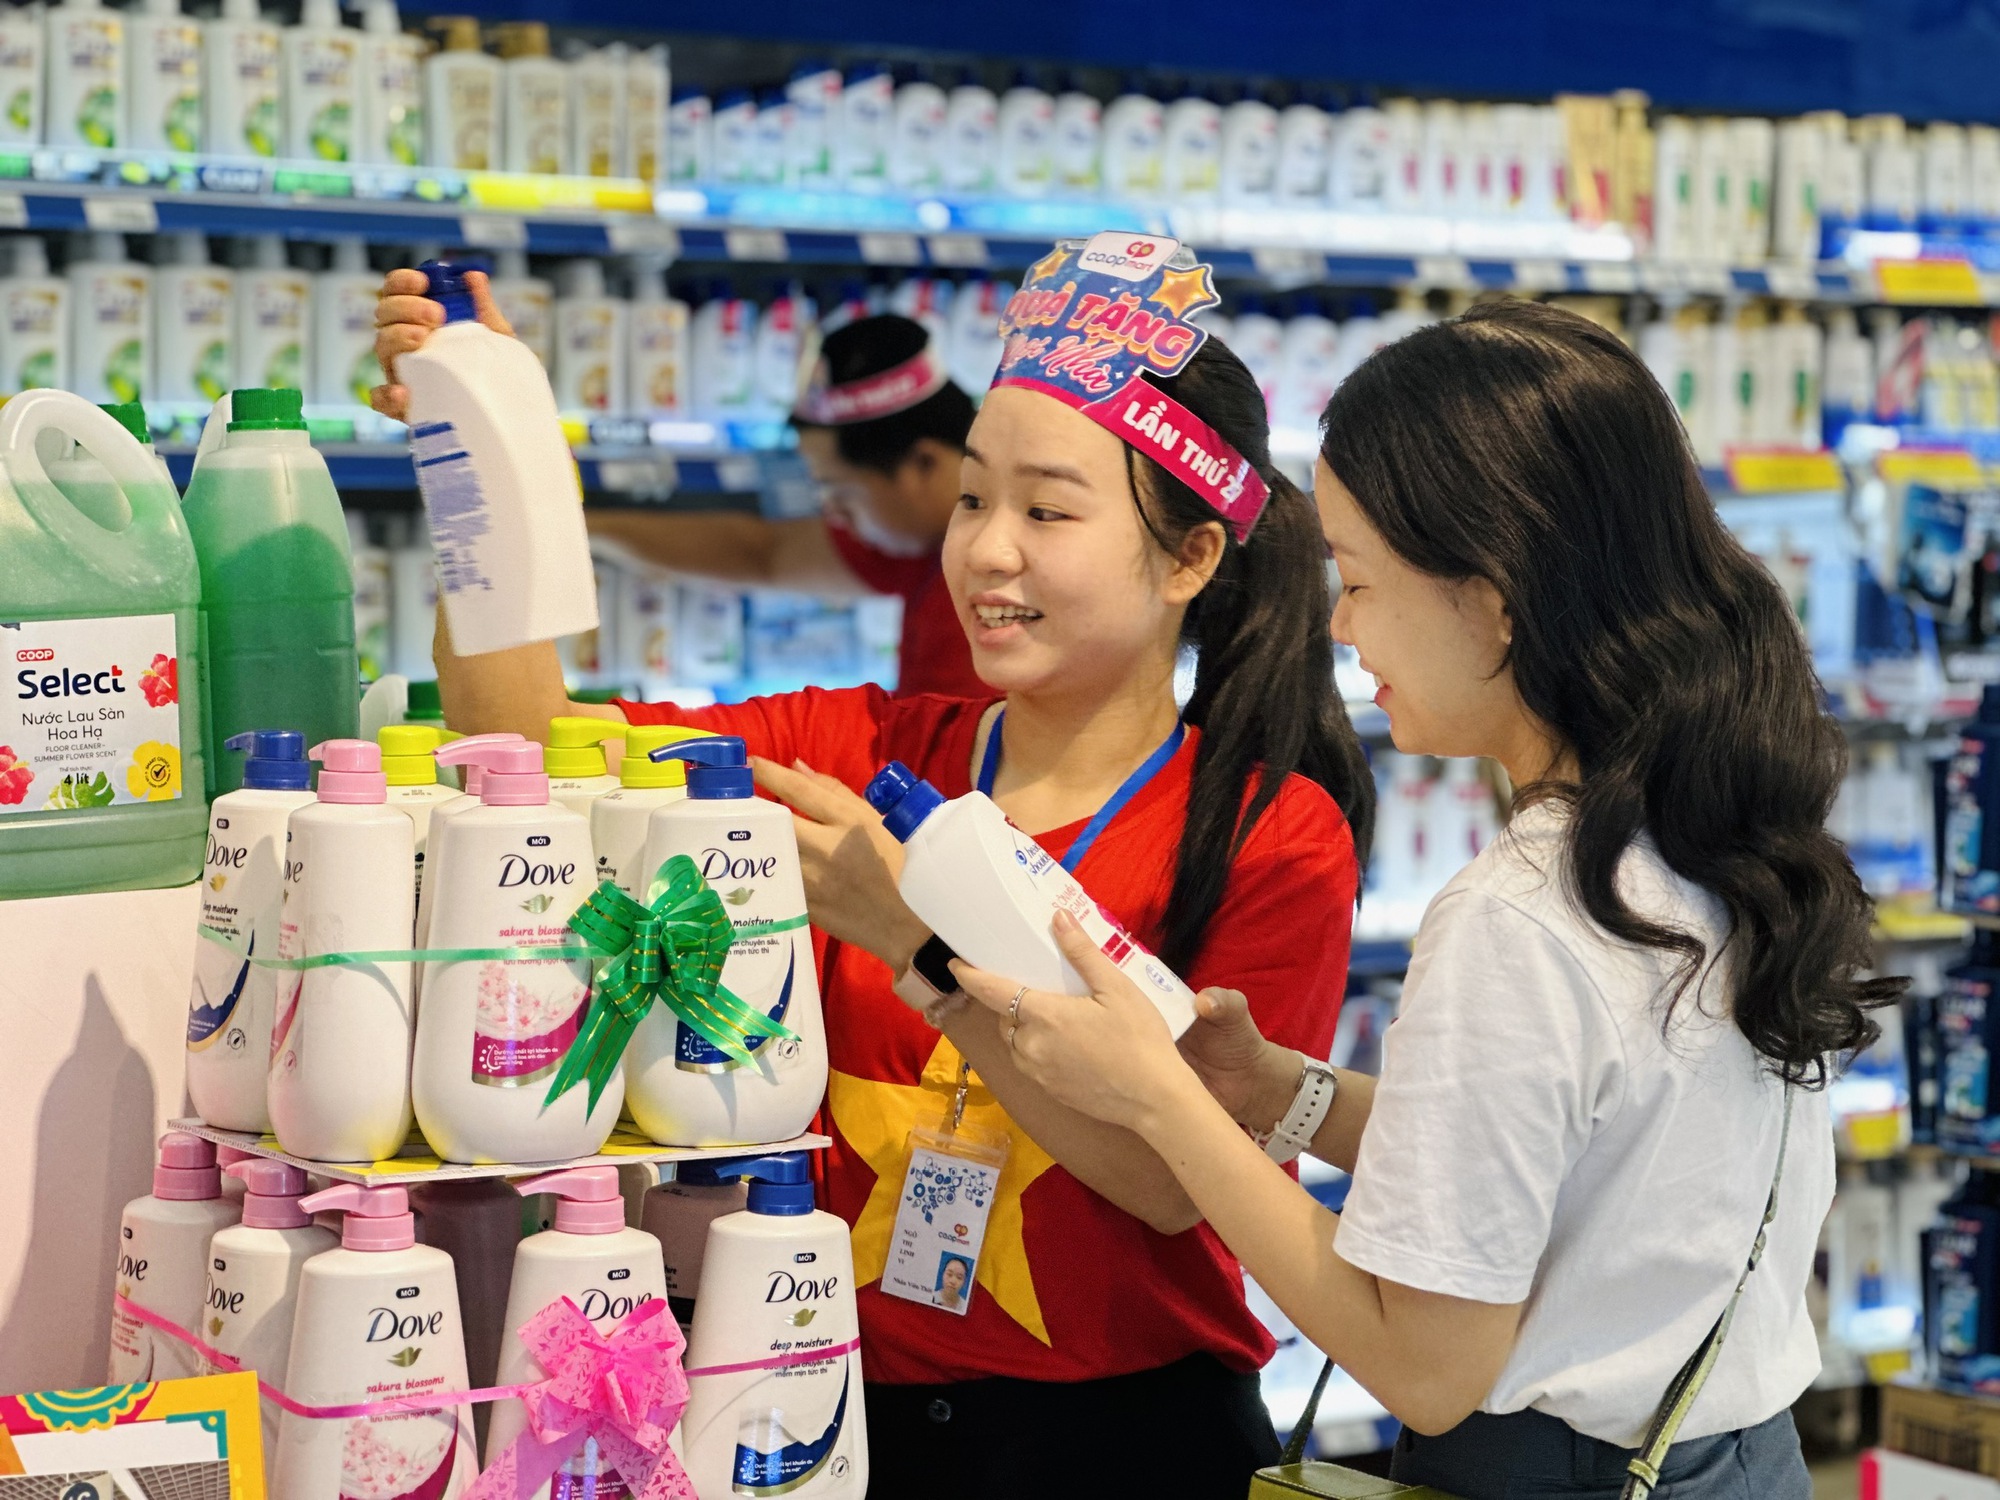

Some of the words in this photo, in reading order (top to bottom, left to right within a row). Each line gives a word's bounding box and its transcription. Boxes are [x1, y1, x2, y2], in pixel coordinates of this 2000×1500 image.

[1123, 401, 1181, 451] LẦN
[1179, 438, 1229, 487] THỨ
[18, 650, 53, 661] COOP
[18, 665, 125, 699] Select
[22, 712, 63, 725] Nước
[68, 710, 94, 722] Lau
[98, 708, 125, 720] Sàn
[48, 728, 78, 740] Hoa
[83, 726, 103, 741] Hạ
[34, 754, 64, 762] SUMMER
[64, 774, 72, 785] 4
[76, 772, 89, 784] lít
[531, 837, 547, 845] MỚI
[732, 832, 747, 840] MỚI
[205, 834, 248, 868] Dove
[498, 854, 575, 887] Dove
[701, 848, 776, 880] Dove
[733, 916, 774, 927] moisture
[499, 926, 534, 937] sakura
[798, 1254, 812, 1262] MỚI
[612, 1270, 627, 1279] MỚI
[205, 1272, 245, 1314] Dove
[401, 1288, 416, 1297] MỚI
[765, 1270, 838, 1303] Dove
[366, 1307, 443, 1342] Dove
[770, 1339, 792, 1351] deep
[795, 1337, 833, 1349] moisture
[366, 1381, 402, 1394] sakura
[405, 1376, 445, 1390] blossoms
